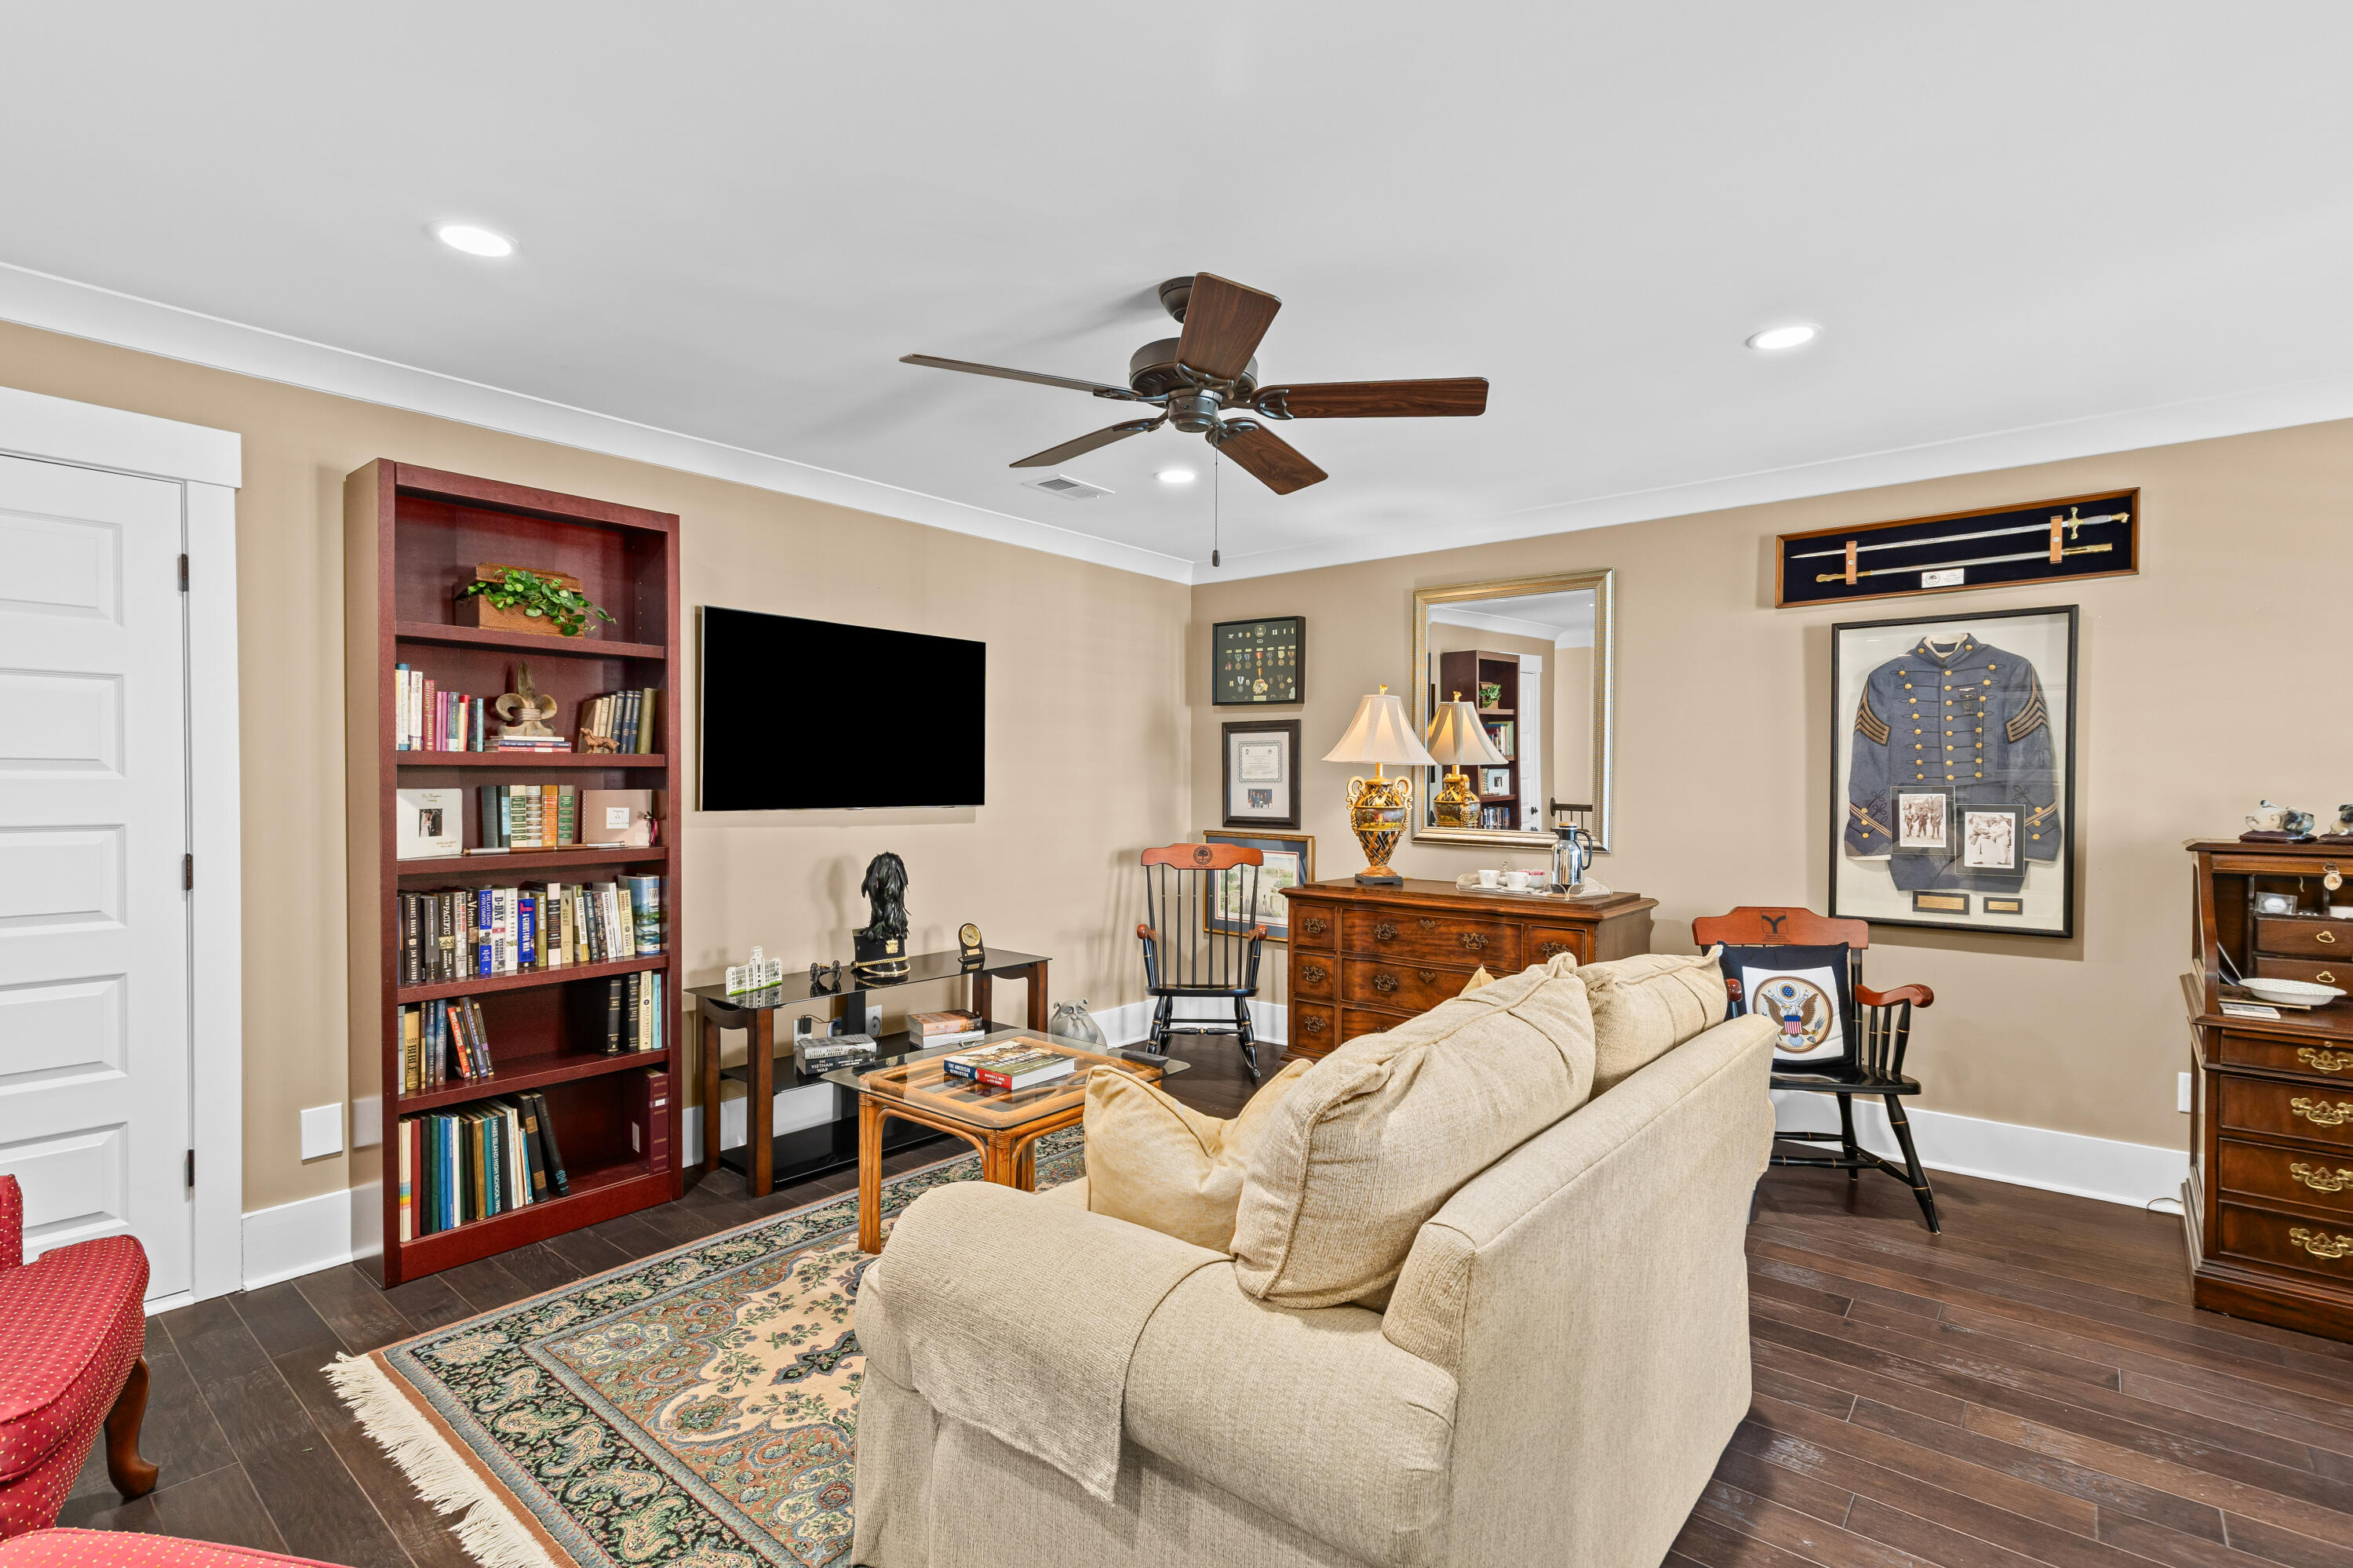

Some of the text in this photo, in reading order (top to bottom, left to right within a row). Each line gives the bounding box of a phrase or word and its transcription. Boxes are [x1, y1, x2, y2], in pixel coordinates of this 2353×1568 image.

[467, 900, 477, 926] Victors
[522, 917, 530, 933] GENIUS
[522, 941, 530, 952] WAR
[407, 1044, 417, 1074] BIBLE
[949, 1069, 969, 1078] REVOLUTION
[954, 1064, 971, 1073] AMERICAN
